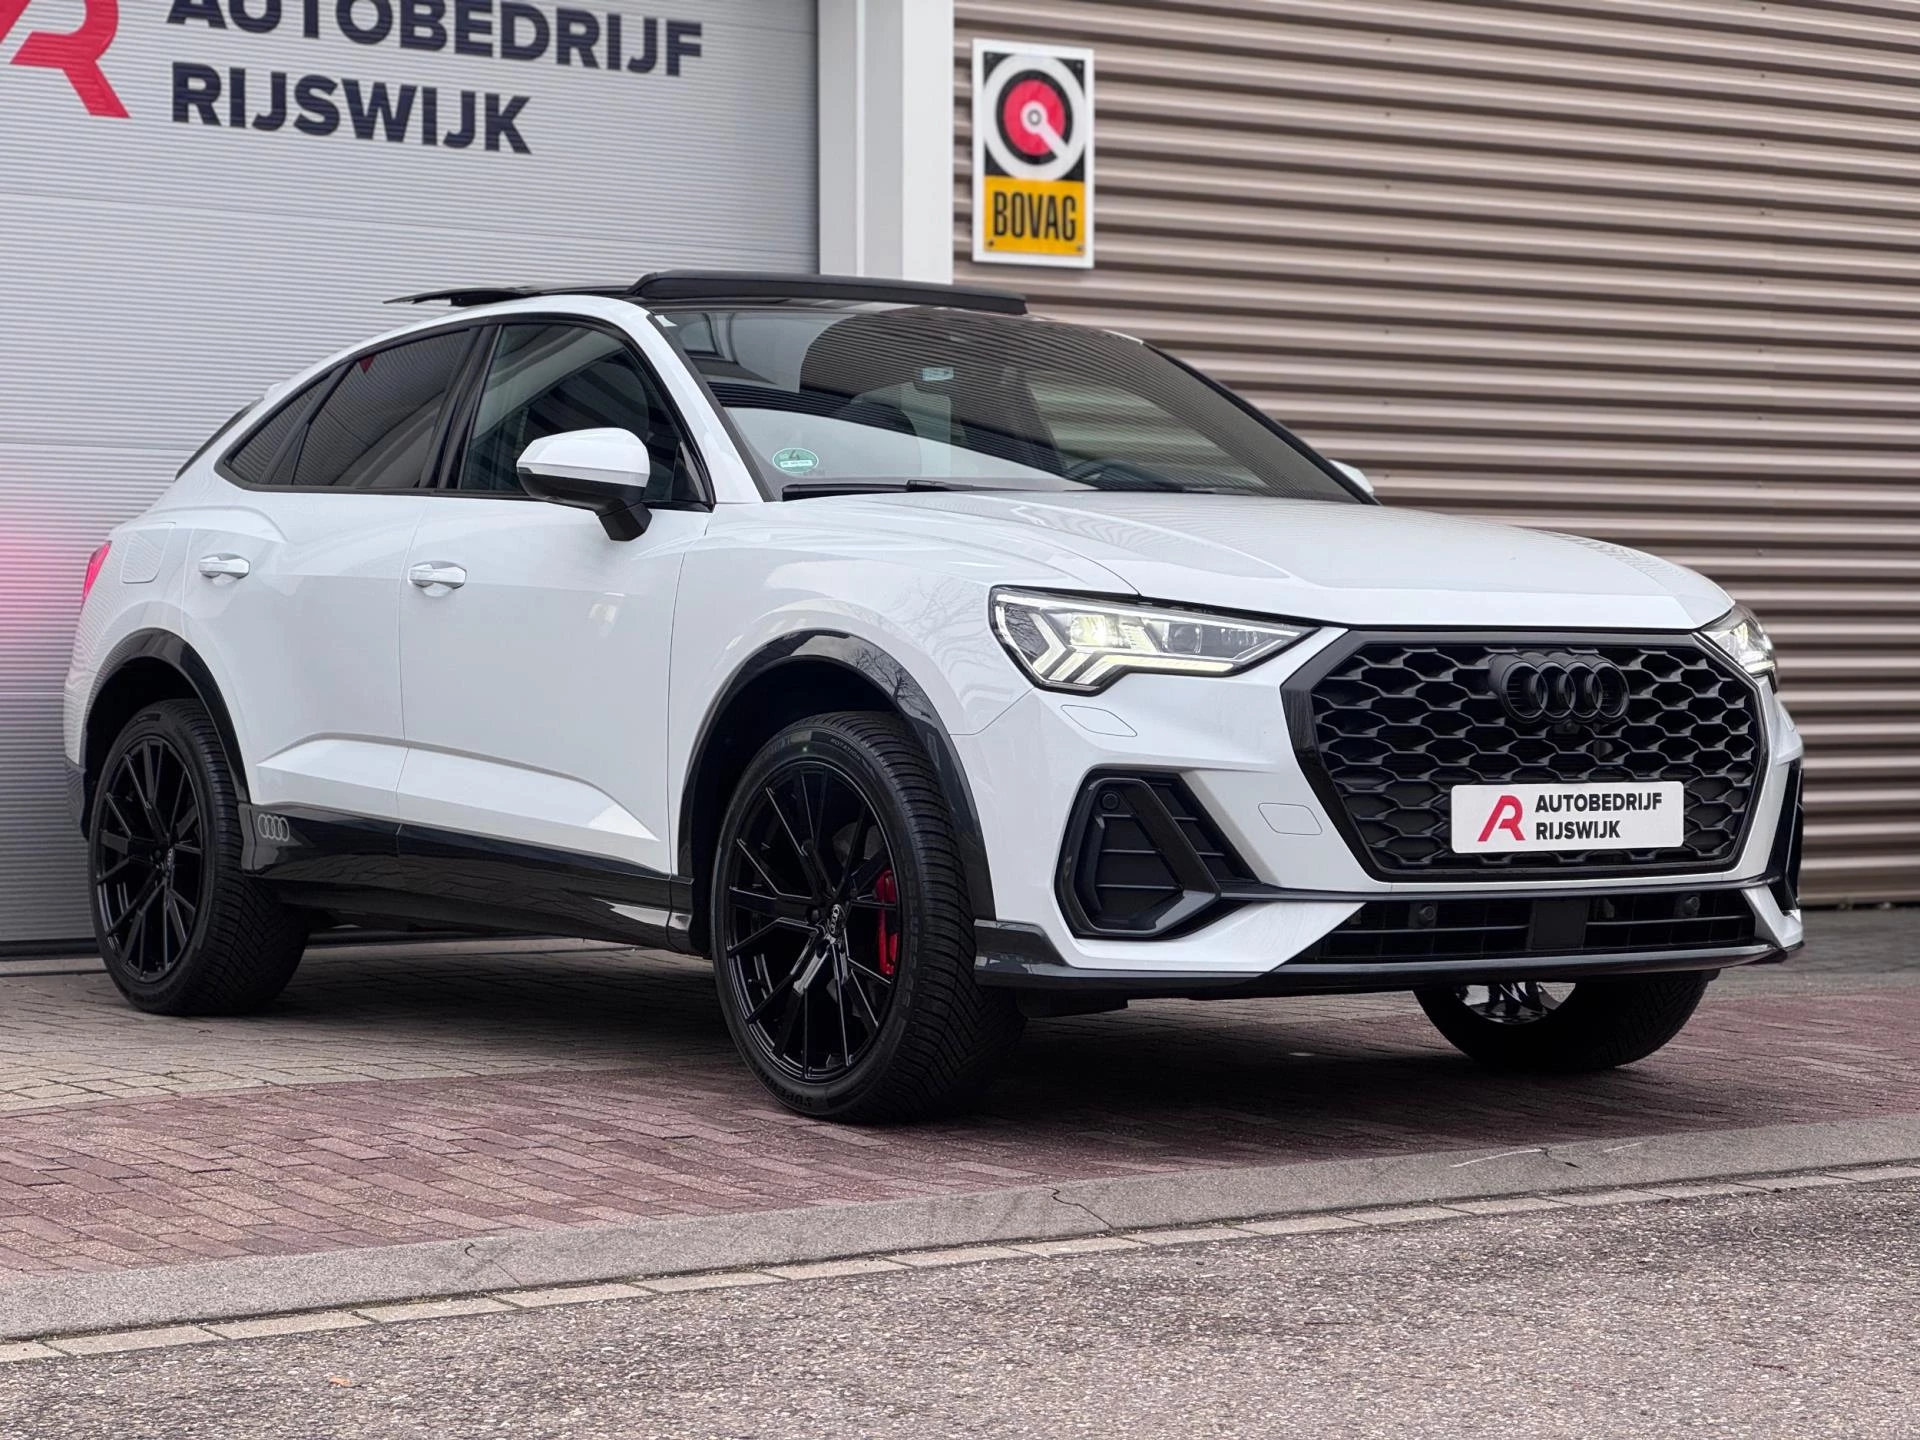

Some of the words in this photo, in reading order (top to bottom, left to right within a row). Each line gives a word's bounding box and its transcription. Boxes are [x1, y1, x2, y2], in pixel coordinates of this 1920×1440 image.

[172, 61, 532, 155] RIJSWIJK
[993, 191, 1077, 242] BOVAG
[1535, 792, 1663, 813] AUTOBEDRIJF
[1535, 820, 1621, 841] RIJSWIJK
